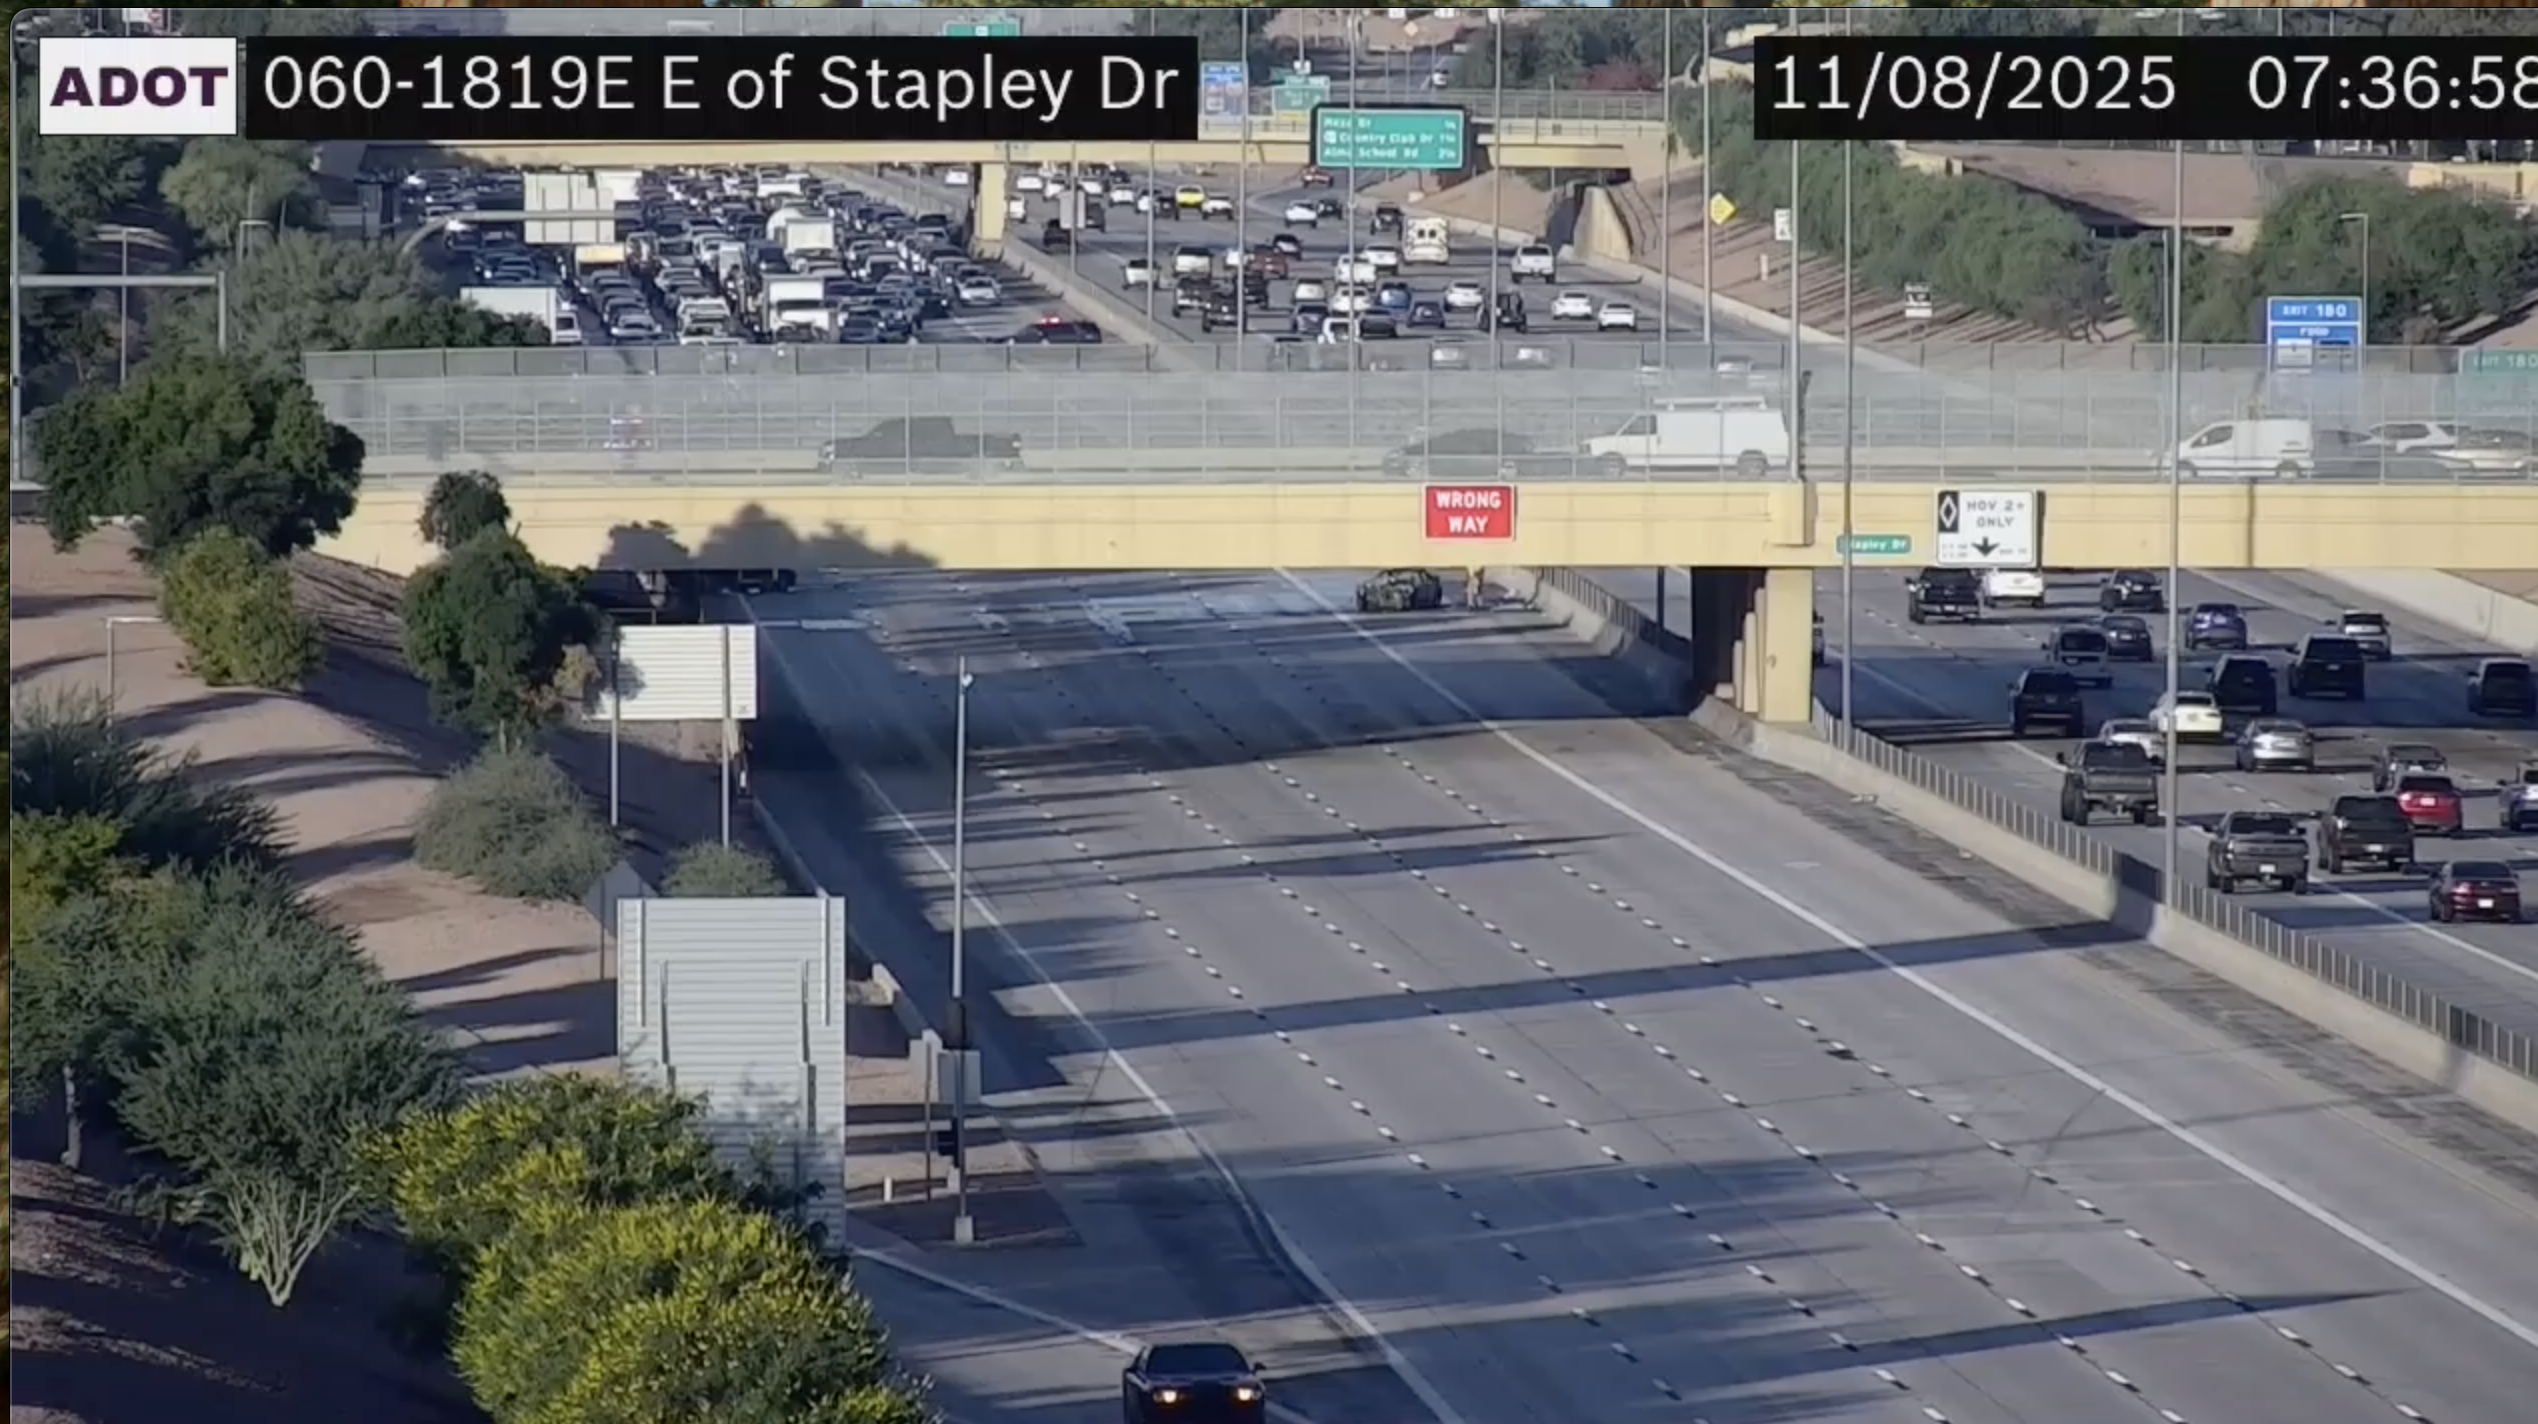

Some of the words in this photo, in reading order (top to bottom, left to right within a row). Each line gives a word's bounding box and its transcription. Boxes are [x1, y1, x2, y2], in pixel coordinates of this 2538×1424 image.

[2317, 304, 2347, 318] 180
[1436, 490, 1502, 509] WRONG
[1967, 499, 1997, 512] HOV
[1448, 515, 1489, 533] WAY
[1976, 516, 2014, 528] ONLY
